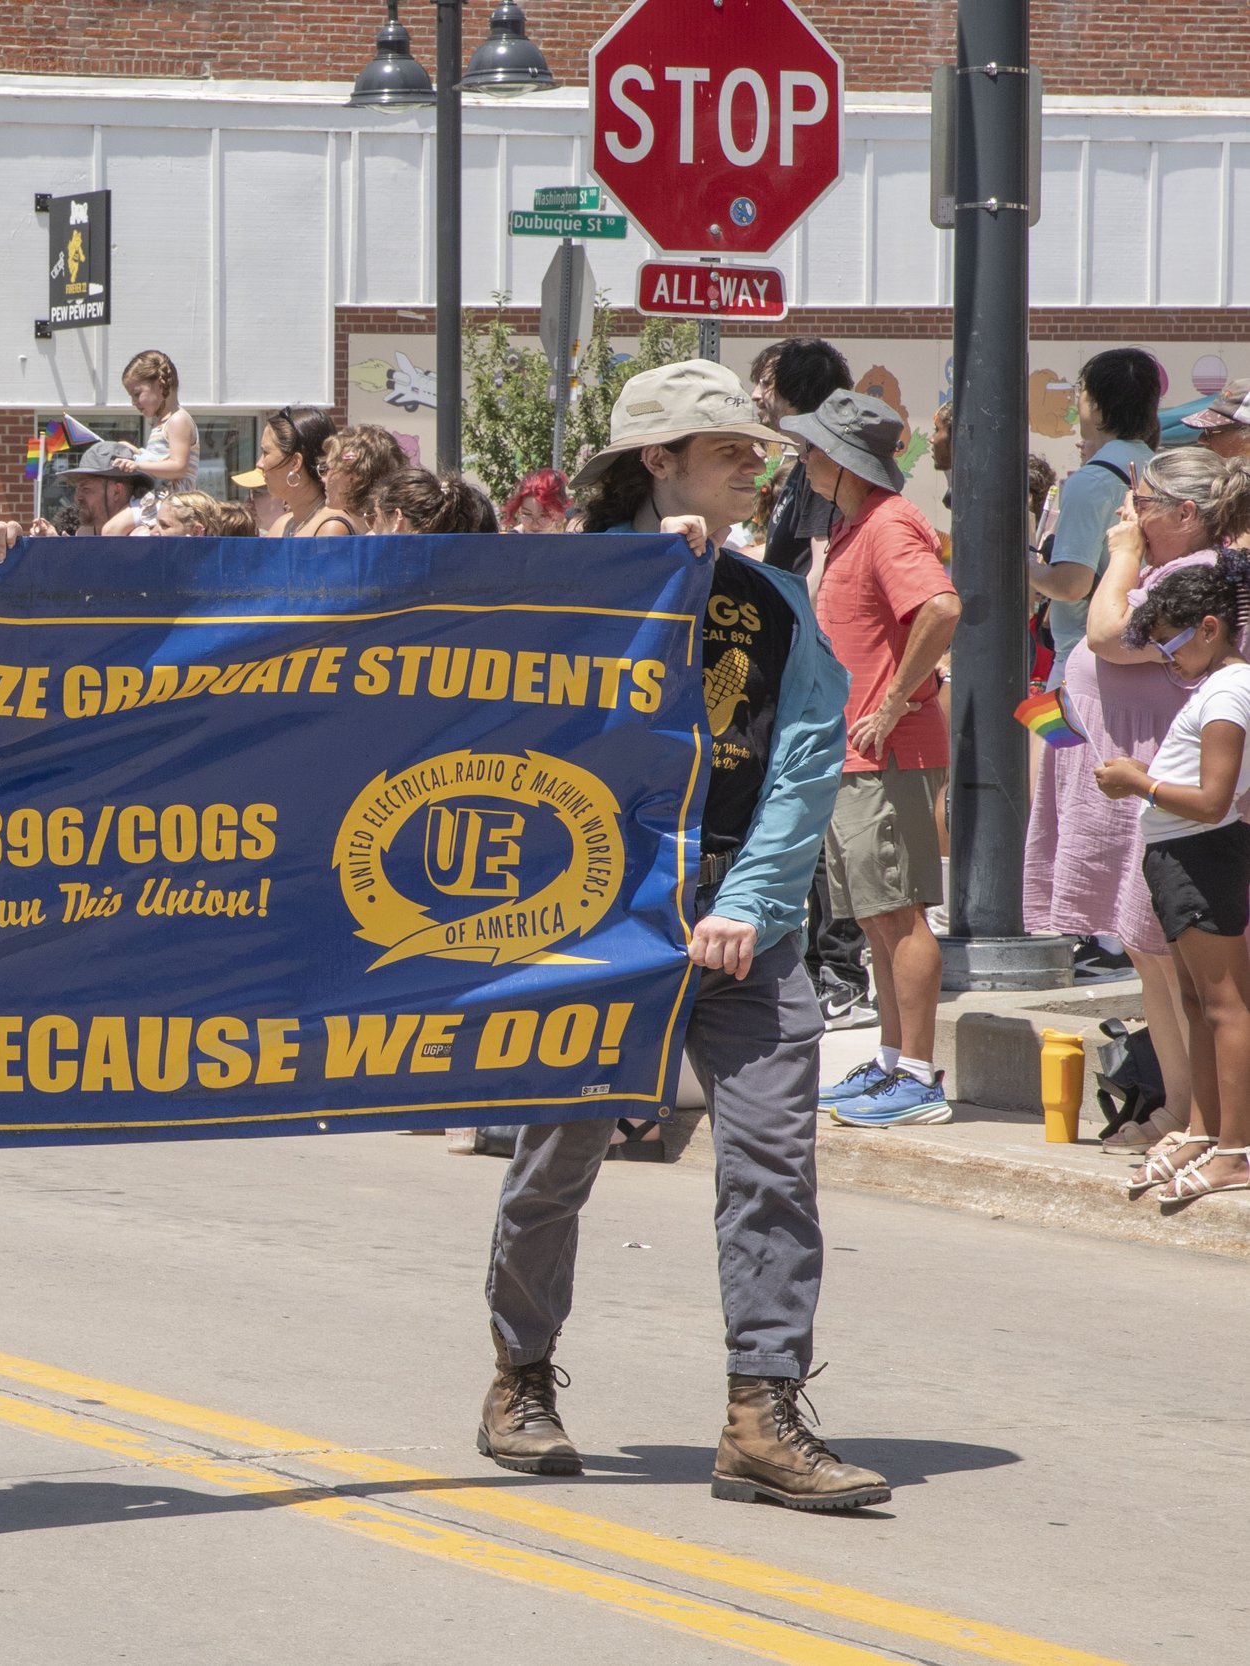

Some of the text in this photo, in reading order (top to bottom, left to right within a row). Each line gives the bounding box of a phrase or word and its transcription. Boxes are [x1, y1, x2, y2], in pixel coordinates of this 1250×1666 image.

[605, 64, 829, 167] STOP
[534, 190, 578, 208] Washington
[579, 190, 588, 205] St
[514, 214, 582, 234] Dubuque
[587, 218, 603, 232] St
[652, 273, 769, 308] ALL WAY
[51, 301, 105, 322] PEW PEW PEW
[707, 594, 762, 632] GS
[702, 628, 753, 645] CAL 896
[63, 647, 348, 720] GRADUATE
[353, 646, 666, 714] STUDENTS
[723, 742, 751, 759] Works
[349, 829, 375, 893] UNITED
[455, 759, 505, 783] RADIO
[510, 762, 528, 792] &
[529, 769, 594, 820] MACHINE
[579, 815, 612, 899] WORKERS
[424, 806, 526, 897] UE
[59, 882, 122, 923] This
[136, 877, 271, 917] Union!
[445, 902, 565, 945] OF AMERICA
[323, 1014, 464, 1079] WE
[475, 1002, 635, 1070] DO!
[423, 1044, 444, 1055] UGP
